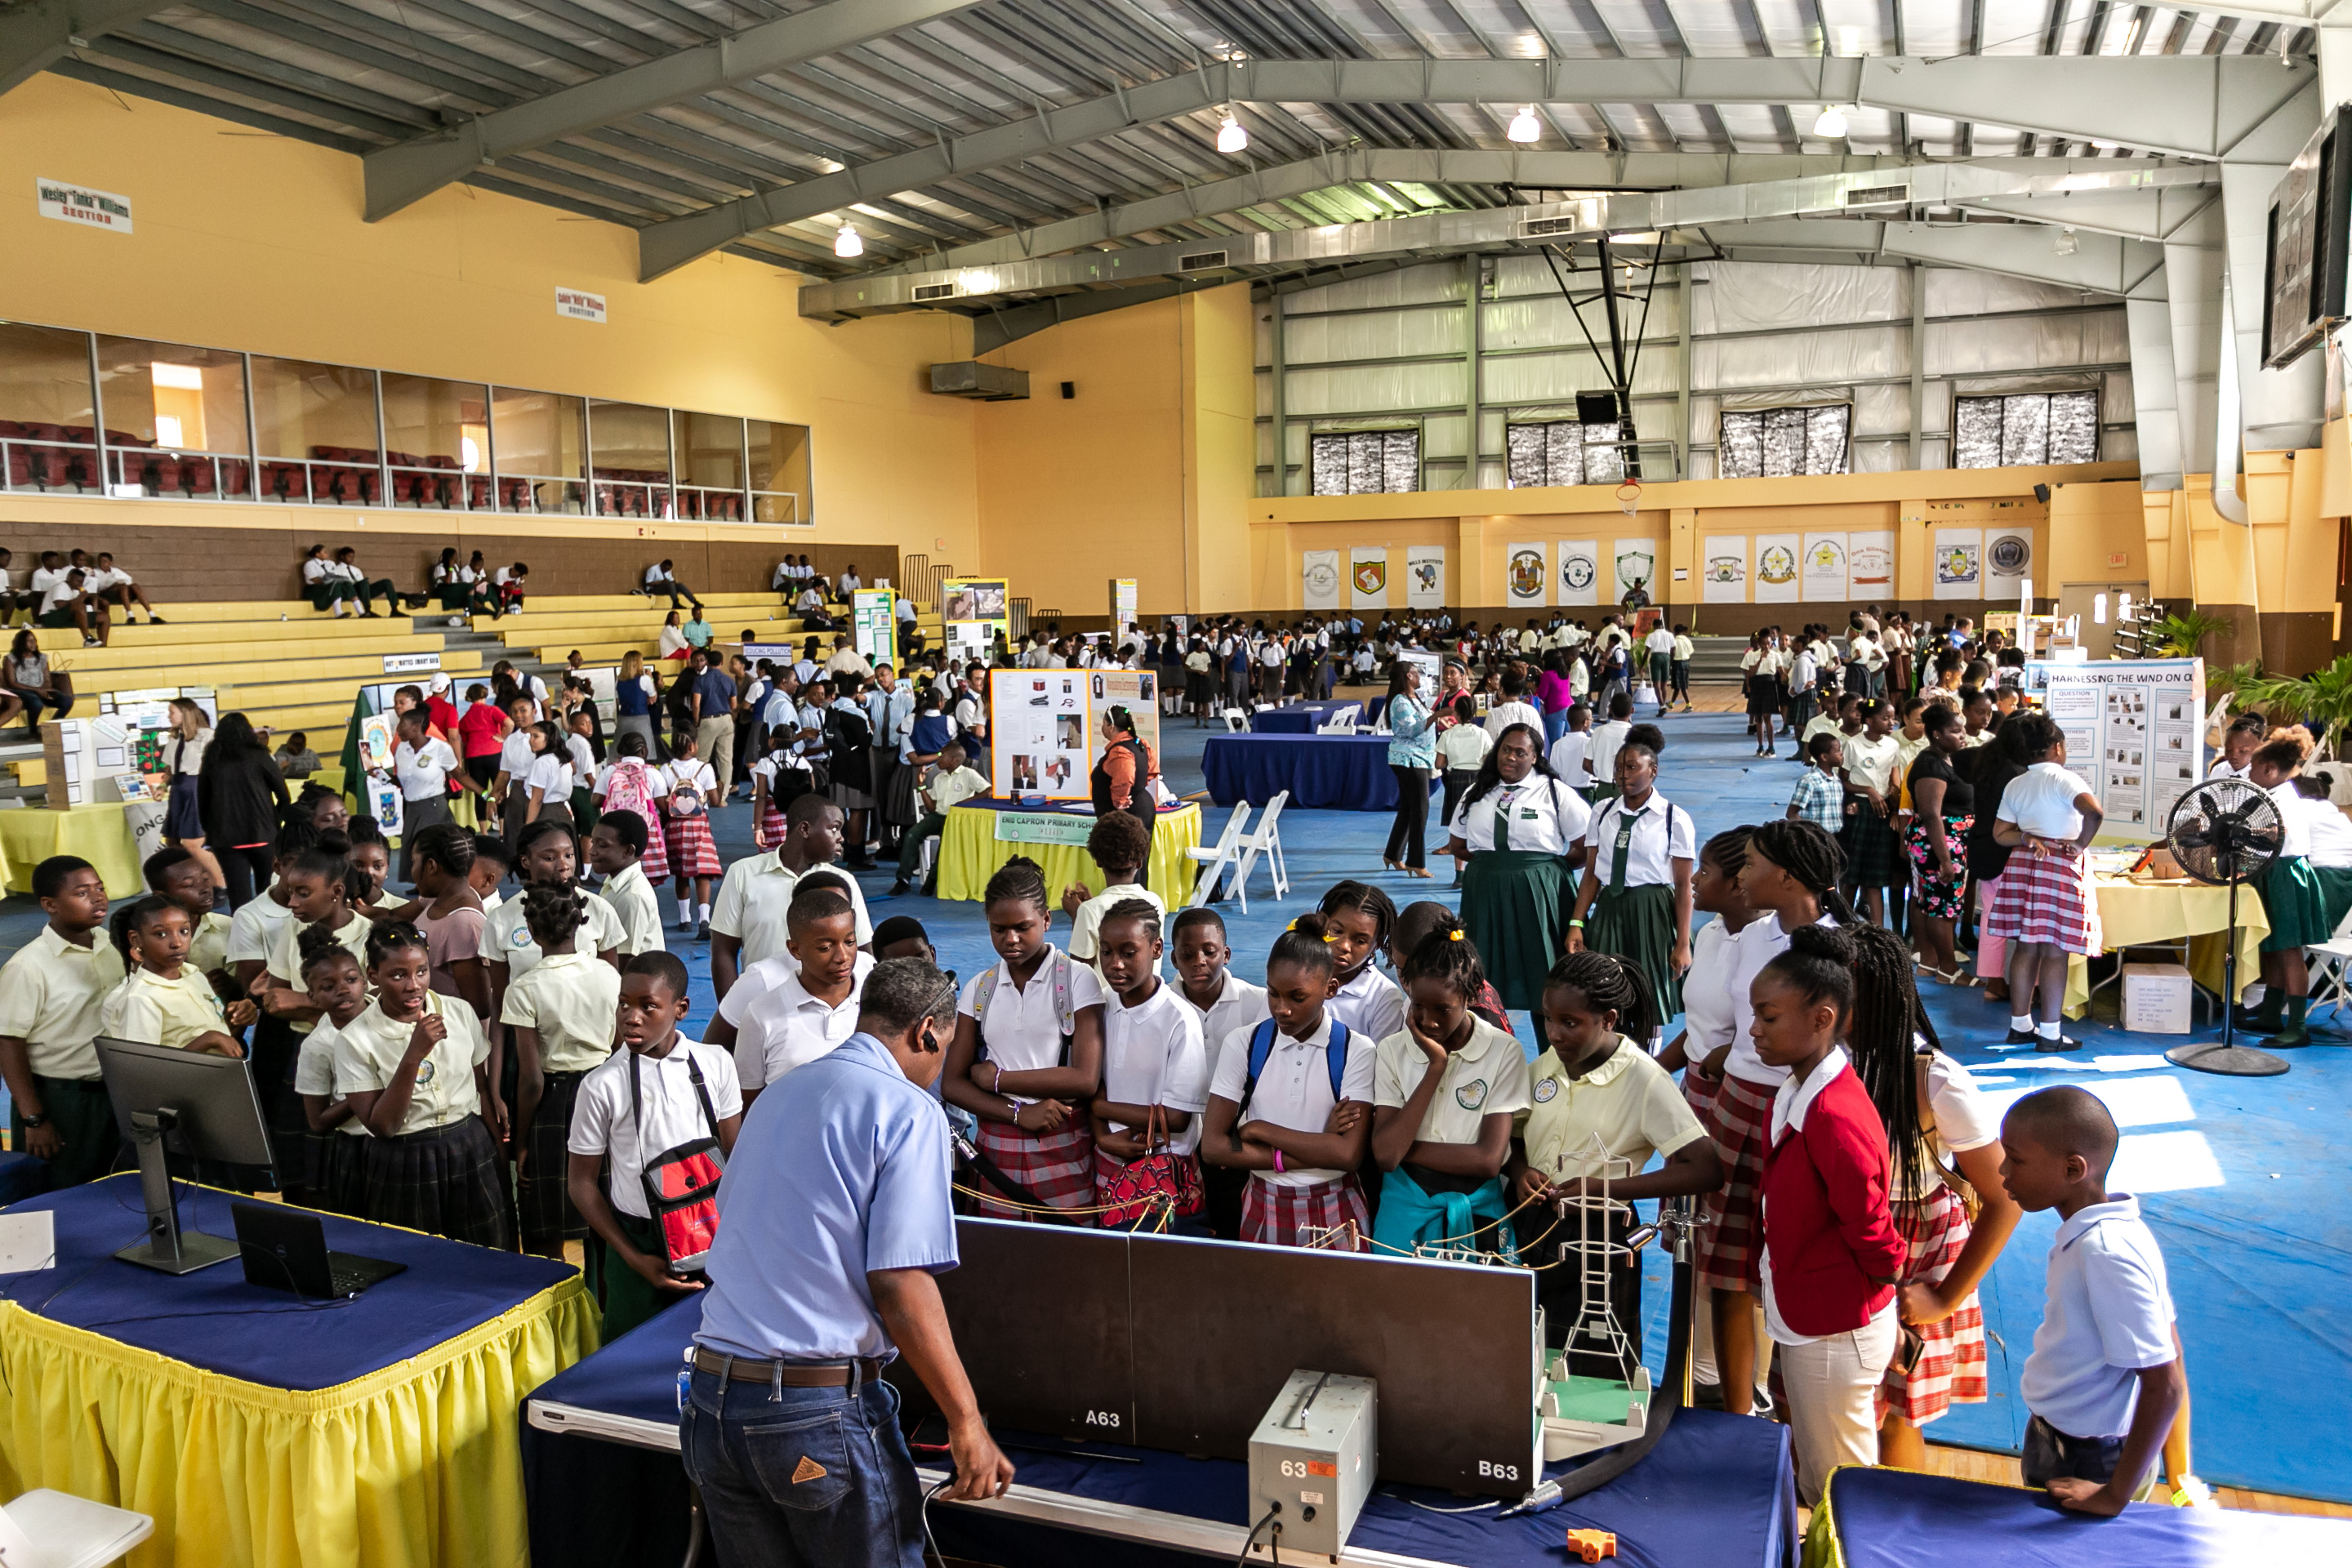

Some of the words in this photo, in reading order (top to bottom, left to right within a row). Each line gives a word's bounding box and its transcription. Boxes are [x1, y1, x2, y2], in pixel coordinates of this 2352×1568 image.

[40, 186, 67, 205] Wesley
[98, 197, 129, 218] Williams
[63, 206, 111, 225] SECTION
[2052, 675, 2114, 683] HARNESSING
[2117, 674, 2133, 683] THE
[2136, 673, 2163, 683] WIND
[2165, 673, 2180, 682] ON
[1047, 818, 1076, 827] PRIMARY
[1085, 1410, 1120, 1428] A63
[1281, 1459, 1307, 1478] 63
[1478, 1460, 1519, 1481] B63
